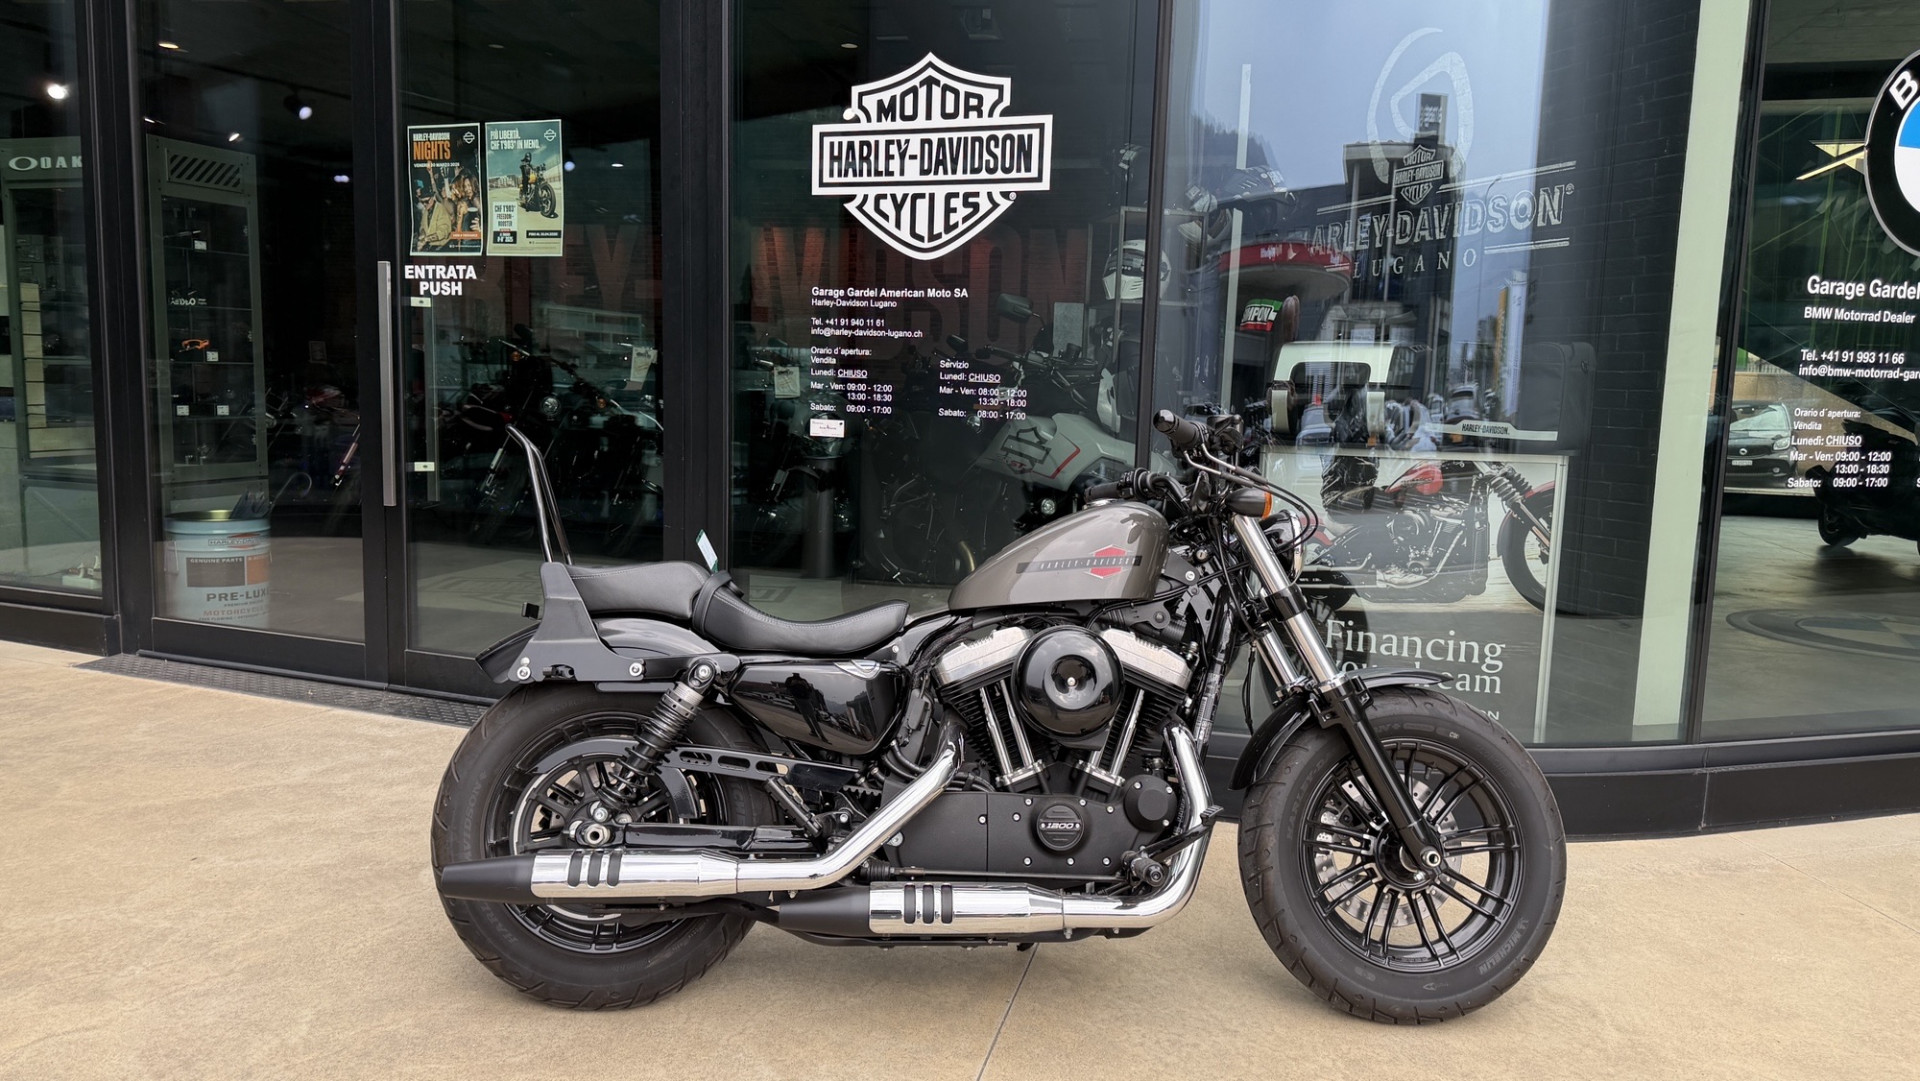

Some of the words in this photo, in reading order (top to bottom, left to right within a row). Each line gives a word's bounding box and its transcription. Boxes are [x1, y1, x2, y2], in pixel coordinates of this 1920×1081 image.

[877, 75, 984, 123] MOTOR
[413, 140, 451, 161] NIGHTS
[490, 140, 500, 151] CHF
[829, 133, 1033, 178] HARLEY-DAVIDSON
[1407, 148, 1433, 165] MOTOR
[1395, 163, 1442, 184] HARLEY-DAVIDSON
[1402, 184, 1432, 203] CYCLES
[874, 192, 980, 243] CYCLES
[1353, 248, 1477, 279] LUGANO
[404, 265, 477, 280] ENTRATA
[419, 281, 463, 296] PUSH
[811, 287, 844, 299] Garage
[847, 287, 877, 298] Gardel
[880, 288, 924, 298] American
[927, 288, 951, 298] Moto
[954, 288, 969, 298] SA
[1807, 275, 1865, 300] Garage
[811, 299, 868, 308] Harley-Davidson
[870, 300, 897, 309] Lugano
[1804, 306, 1833, 319] BMW
[1834, 308, 1881, 322] Motorrad
[1883, 311, 1915, 323] Dealer
[811, 318, 824, 326] Tel.
[825, 318, 838, 326] +41
[840, 318, 849, 326] 91
[866, 319, 874, 327] 11
[876, 319, 884, 327] 61
[811, 328, 923, 338] info@harley-davidson-lugano.ch
[811, 346, 832, 354] Orario
[811, 356, 836, 364] Vendita
[1801, 349, 1818, 361] Tel.
[1821, 350, 1840, 362] +41
[1842, 351, 1854, 362] 91
[1856, 352, 1876, 363] 993
[1878, 352, 1890, 364] 11
[1892, 353, 1905, 364] 66
[940, 360, 970, 370] Servizio
[838, 369, 868, 378] CHIUSO
[968, 373, 1000, 383] CHIUSO
[830, 382, 846, 390] Ven:
[846, 383, 866, 392] 09:00
[873, 384, 892, 392] 12:00
[940, 386, 954, 394] Mar
[960, 387, 976, 396] Ven:
[978, 388, 999, 396] 08:00
[1006, 390, 1027, 398] 12:00
[848, 392, 866, 400] 13:00
[873, 394, 892, 402] 18:30
[979, 398, 998, 406] 13:30
[1006, 399, 1027, 408] 18:00
[810, 402, 836, 412] Sabato:
[846, 405, 866, 413] 09:00
[872, 406, 892, 414] 17:00
[938, 408, 966, 418] Sabato:
[977, 410, 998, 419] 08:00
[1005, 412, 1026, 420] 17:00
[1794, 408, 1818, 418] Orario
[1793, 422, 1822, 430] Vendita
[1826, 436, 1862, 446] CHIUSO
[1790, 452, 1808, 460] Mar
[1814, 452, 1834, 461] Ven:
[1835, 452, 1860, 462] 09:00
[1868, 452, 1892, 462] 12:00
[1835, 464, 1858, 474] 13:00
[1866, 464, 1890, 474] 18:30
[1788, 478, 1822, 488] Sabato:
[1832, 478, 1858, 488] 09:00
[1864, 478, 1888, 488] 17:00
[1040, 557, 1136, 570] HARLEY-DAVIDSON
[1326, 619, 1506, 673] Financing
